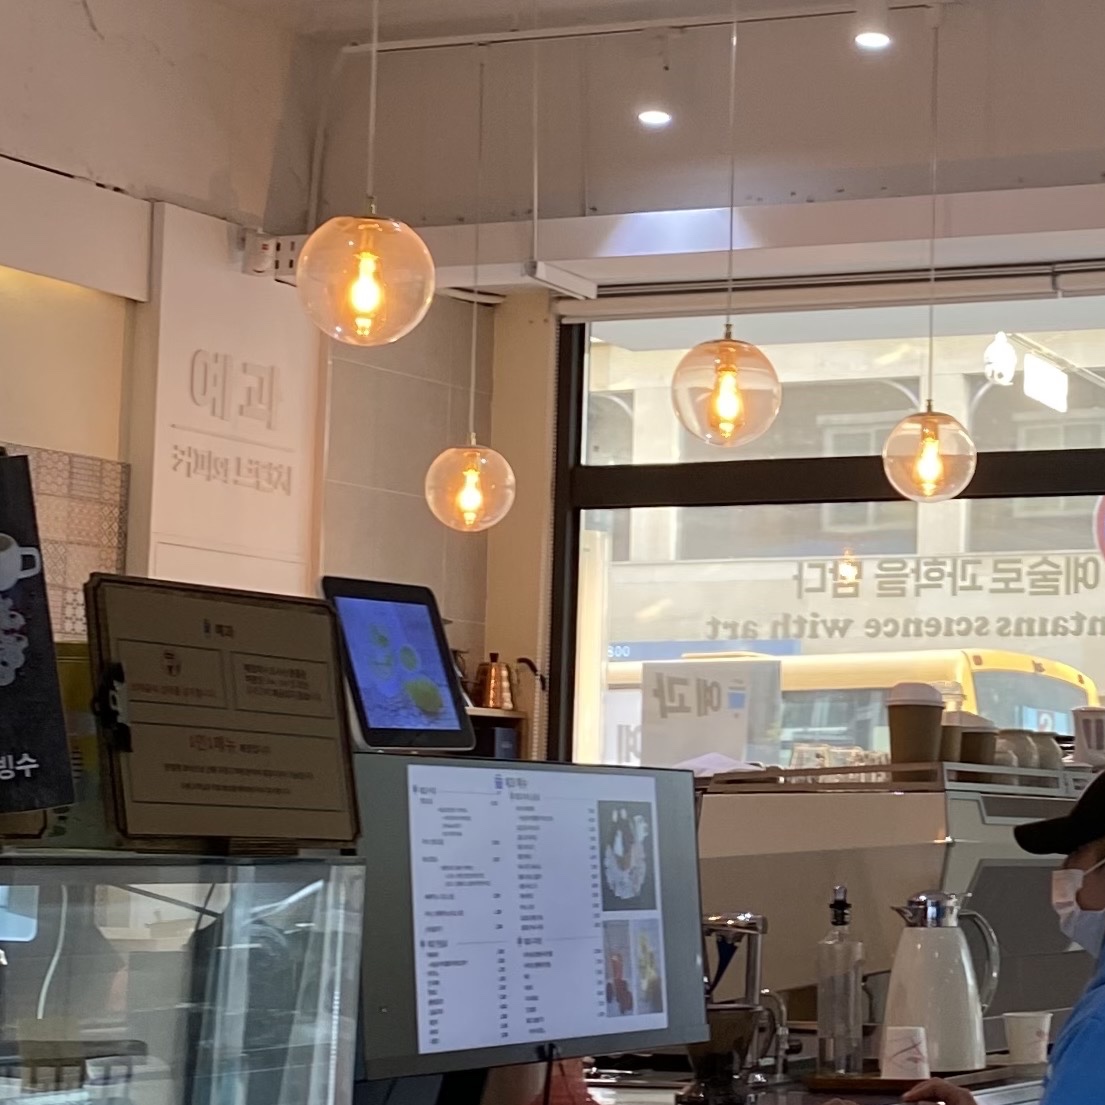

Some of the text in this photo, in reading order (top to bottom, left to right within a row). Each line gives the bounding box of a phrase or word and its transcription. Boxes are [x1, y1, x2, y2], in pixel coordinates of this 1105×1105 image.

[190, 348, 281, 430] 예과
[172, 444, 293, 497] 커피와 브런치
